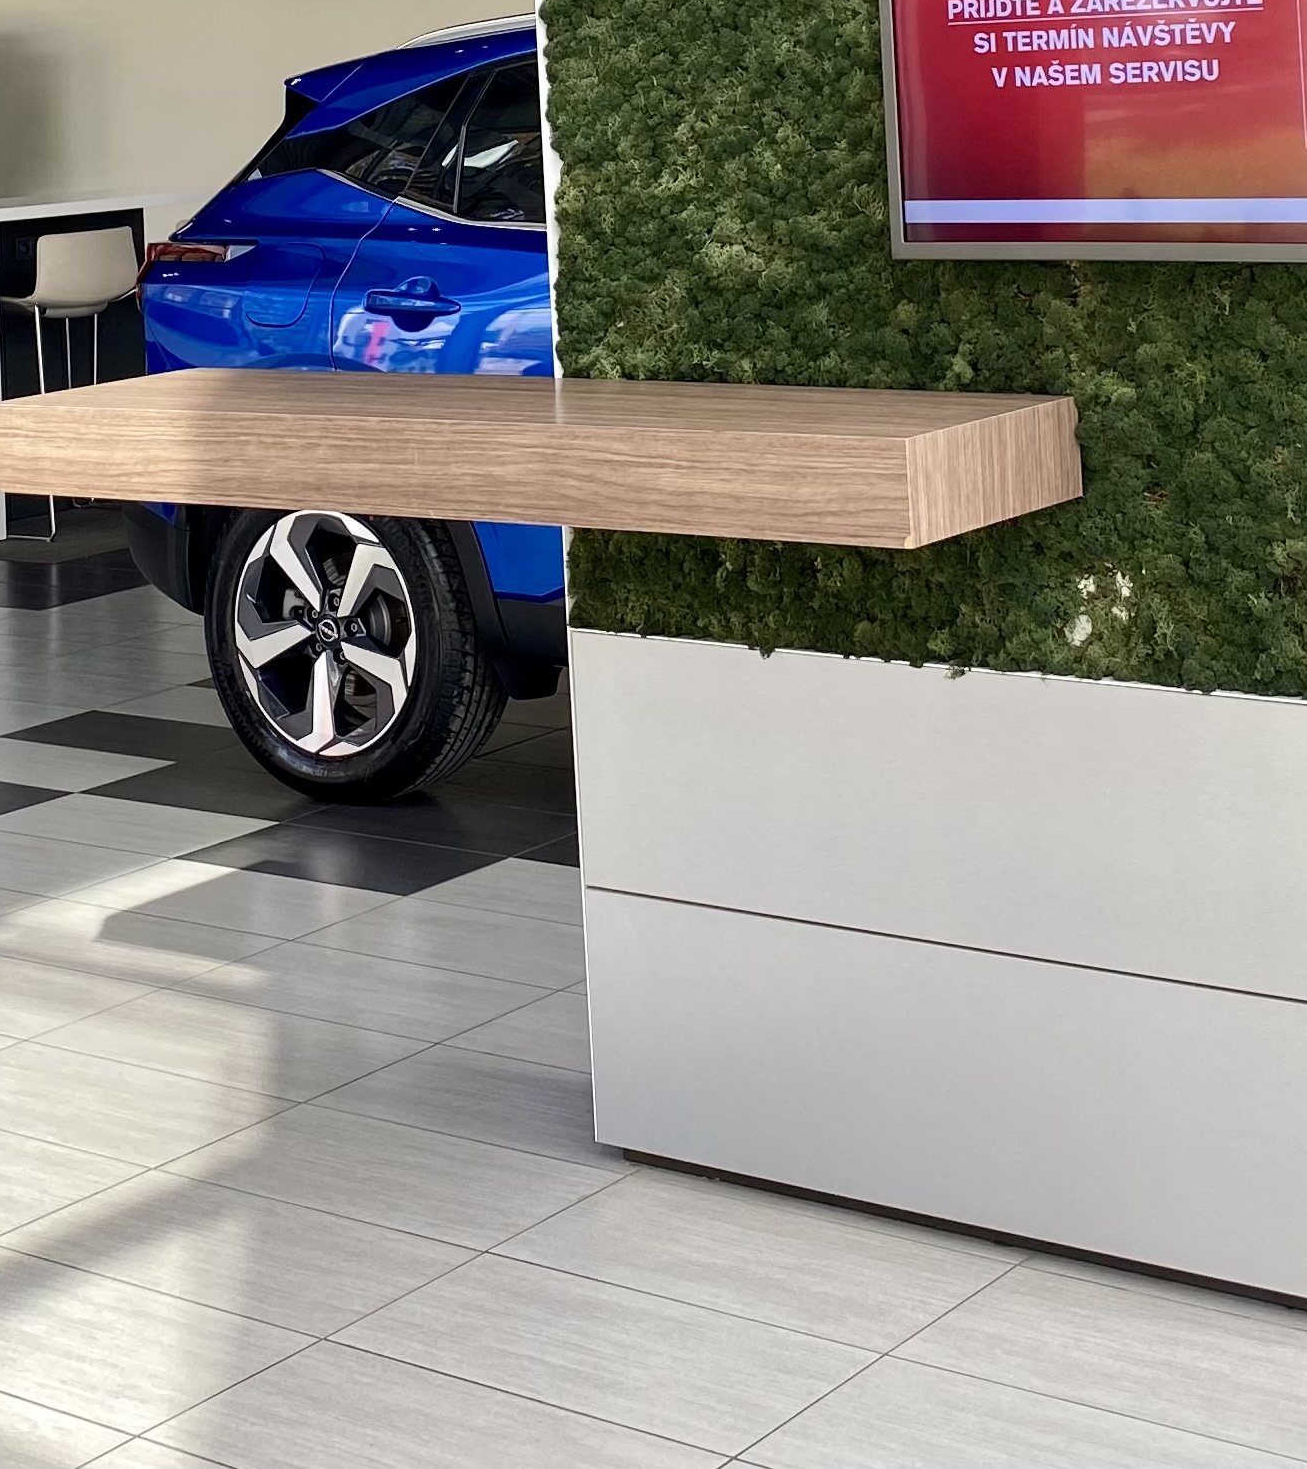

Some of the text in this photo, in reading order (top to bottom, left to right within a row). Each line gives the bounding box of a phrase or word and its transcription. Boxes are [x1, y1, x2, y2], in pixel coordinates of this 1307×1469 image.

[973, 18, 1236, 53] SI TERMÍN NÁVŠTĚVY
[992, 59, 1220, 88] V NAŠEM SERVISU
